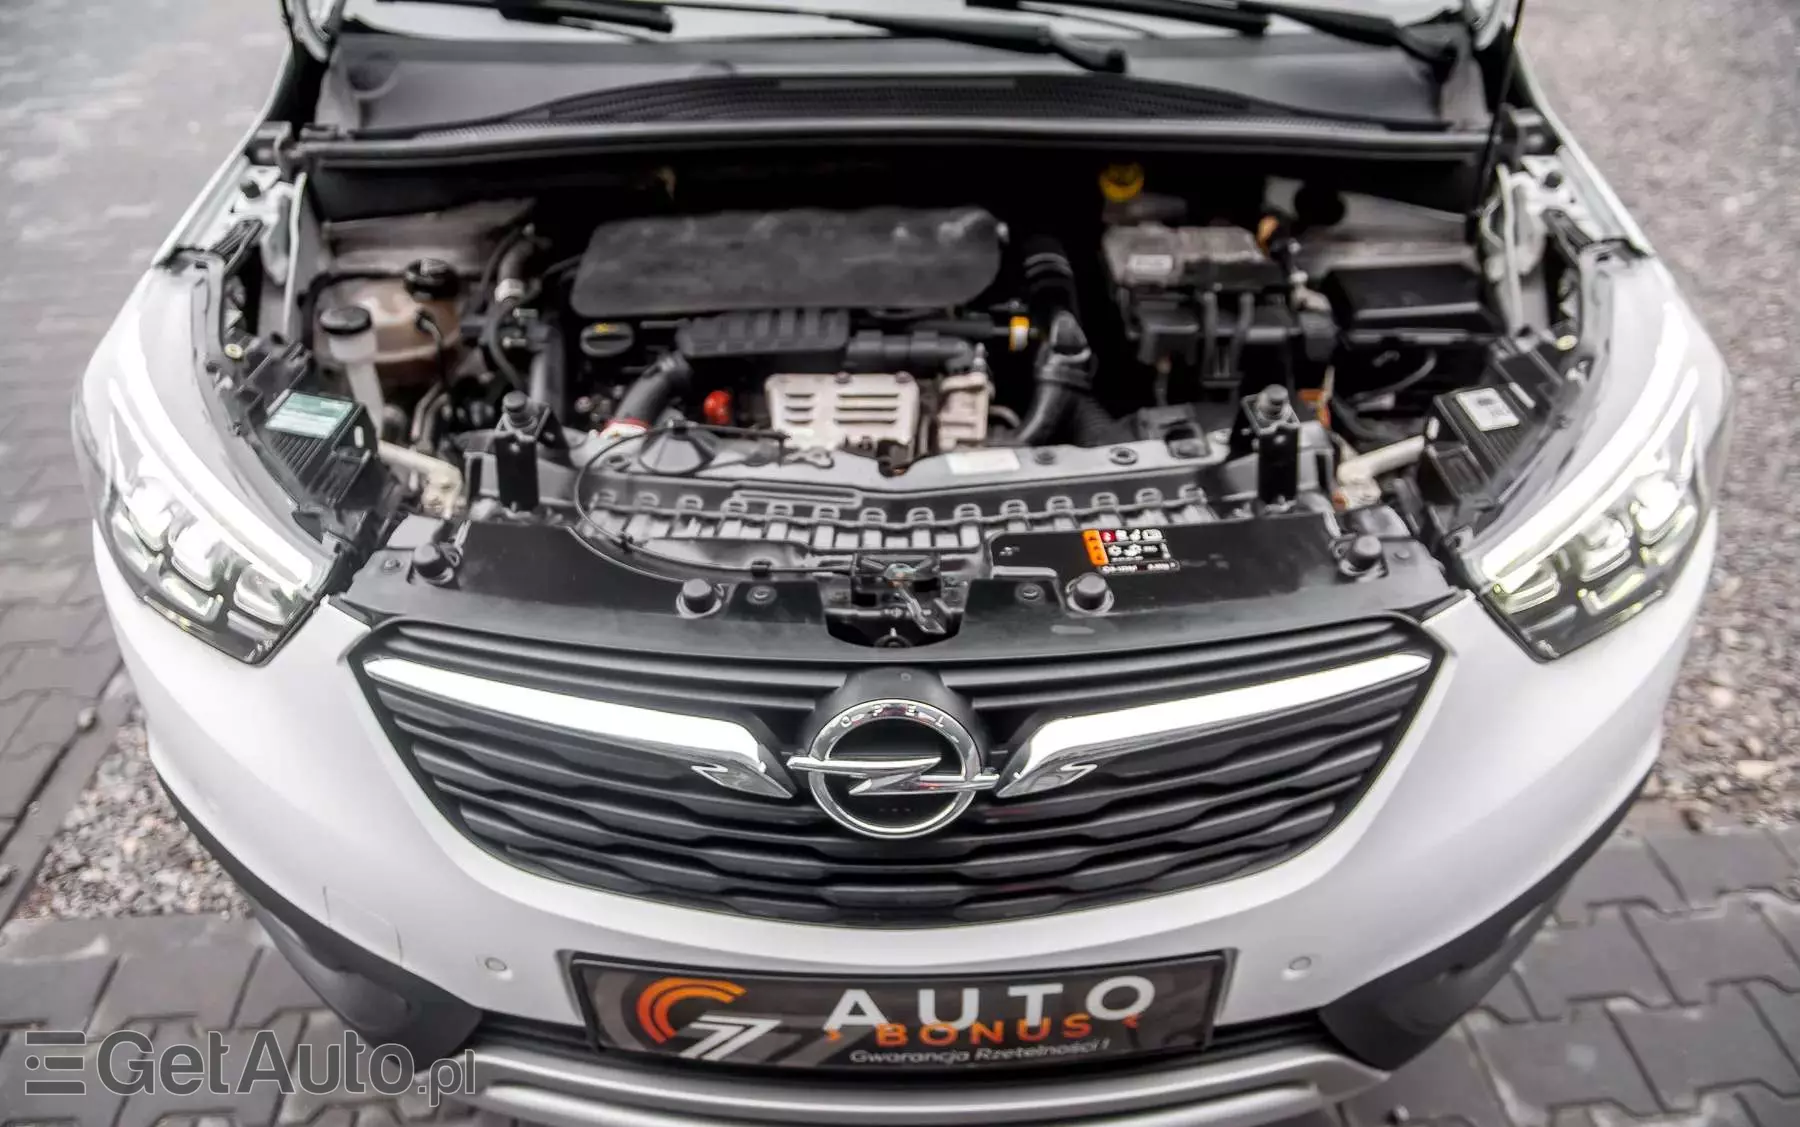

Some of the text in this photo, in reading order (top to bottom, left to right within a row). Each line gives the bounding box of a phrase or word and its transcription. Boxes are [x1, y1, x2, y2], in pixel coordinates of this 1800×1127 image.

[840, 704, 945, 729] OPEL
[822, 975, 1155, 1031] AUTO
[875, 1012, 1092, 1046] BONUS
[849, 1049, 970, 1066] Gwarancja
